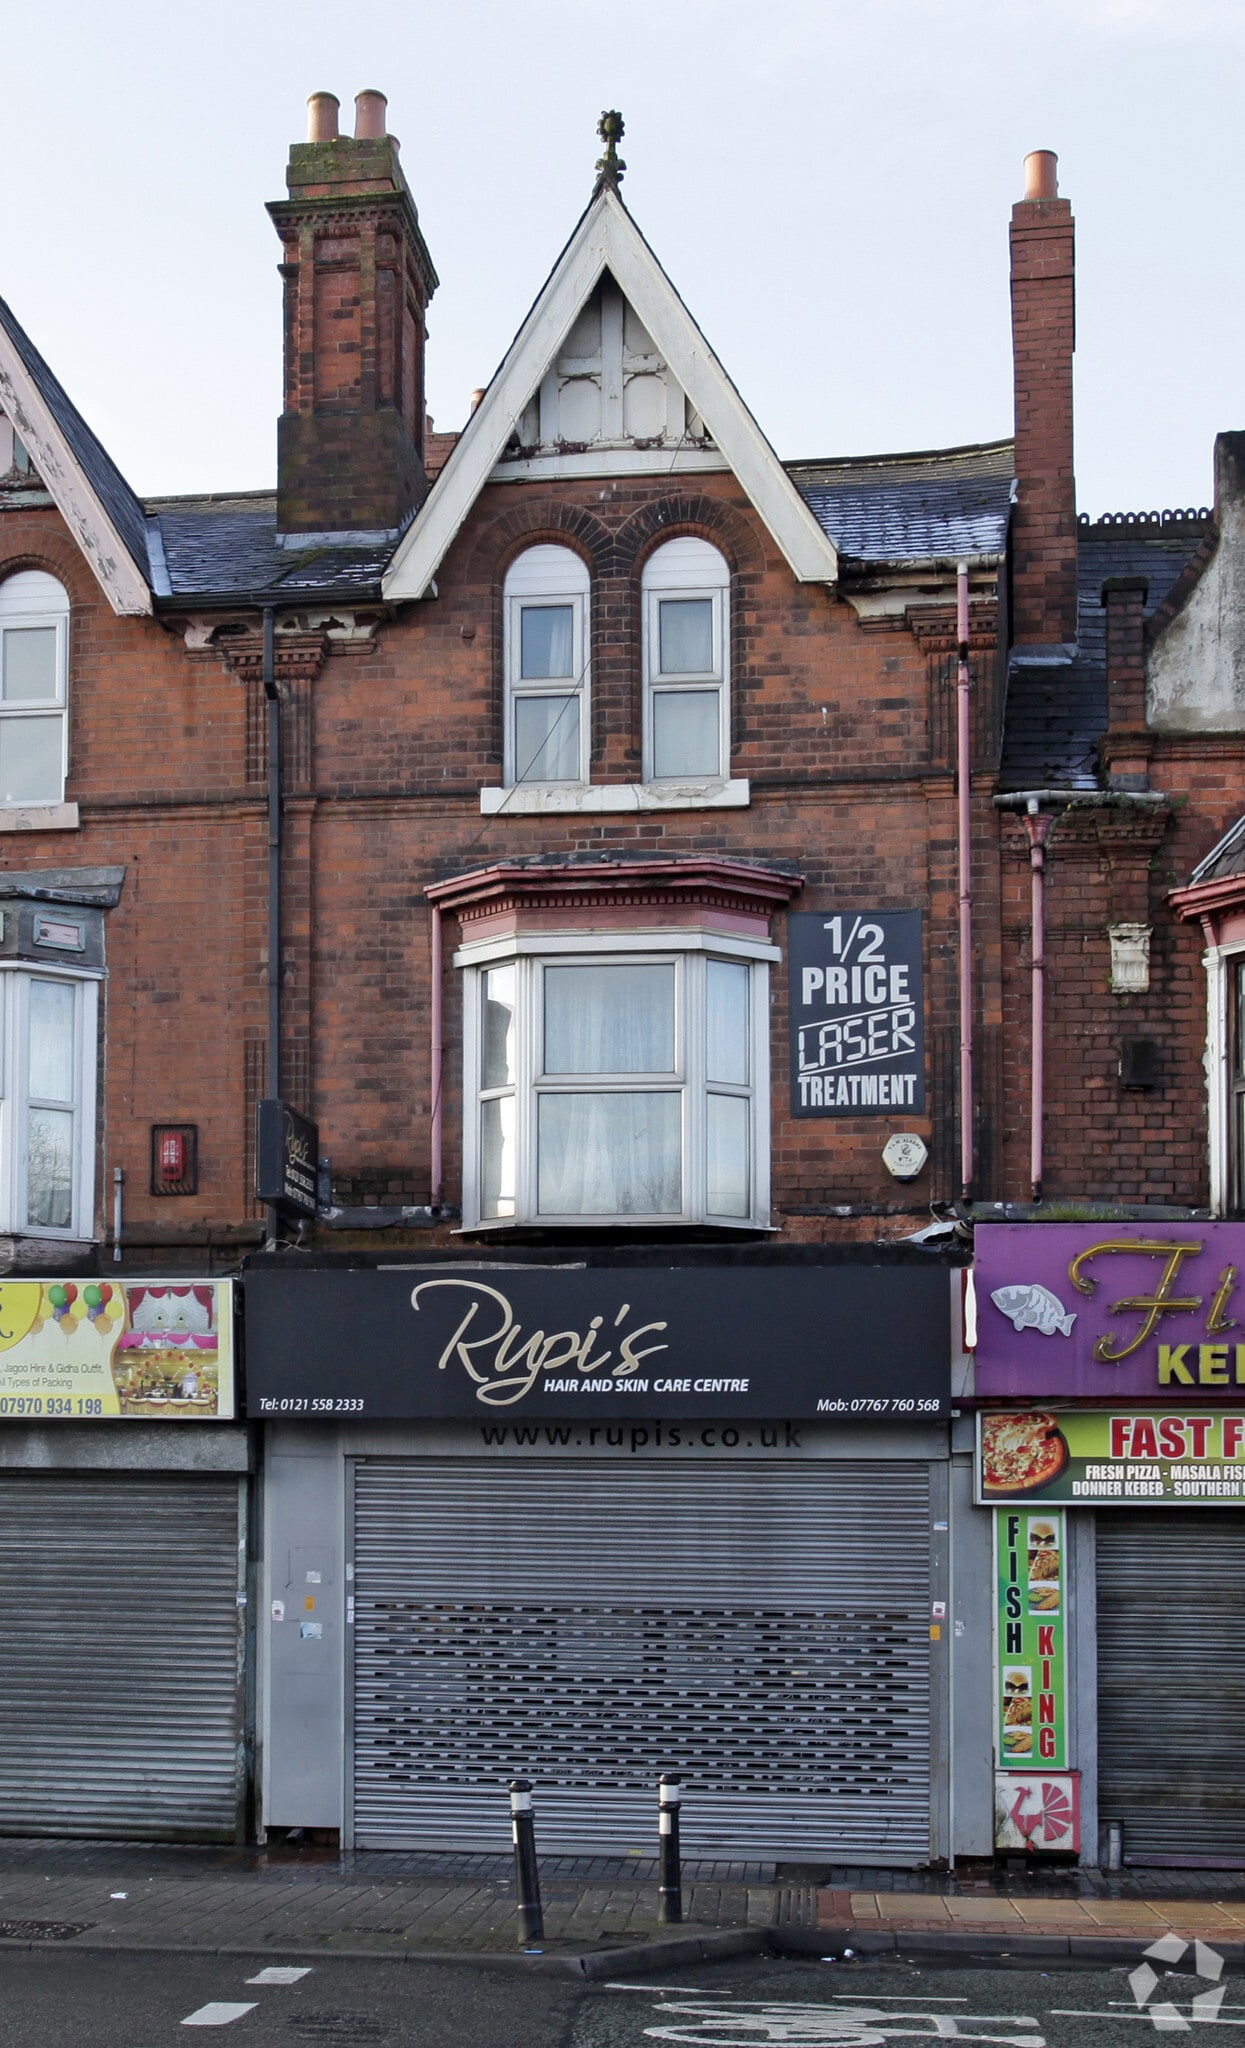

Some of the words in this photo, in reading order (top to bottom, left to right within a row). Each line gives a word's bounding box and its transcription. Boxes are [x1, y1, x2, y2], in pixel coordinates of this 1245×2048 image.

[823, 916, 885, 963] 1/2
[802, 964, 911, 1005] PRICE
[798, 1007, 916, 1071] LASER
[797, 1074, 917, 1107] TREATMENT
[410, 1279, 669, 1406] Rupi's
[4, 1363, 28, 1376] Jagoo
[30, 1363, 46, 1373] Hire
[48, 1364, 54, 1373] &
[56, 1364, 80, 1374] Gidha
[1157, 1343, 1245, 1385] KE
[7, 1376, 30, 1389] Types
[32, 1377, 40, 1387] of
[42, 1377, 73, 1390] Packing
[543, 1378, 579, 1392] HAIR
[580, 1378, 613, 1392] AND
[615, 1378, 649, 1392] SKIN
[653, 1378, 692, 1392] CARE
[693, 1378, 749, 1392] CENTRE
[0, 1397, 42, 1414] 07970
[47, 1398, 72, 1415] 934
[77, 1398, 102, 1415] 198
[260, 1397, 279, 1410] Tel:
[280, 1398, 309, 1411] 0121
[311, 1398, 334, 1411] 558
[334, 1398, 364, 1411] 2333
[816, 1398, 849, 1412] Mob:
[850, 1399, 890, 1412] 07767
[891, 1399, 915, 1412] 760
[916, 1399, 940, 1412] 568
[480, 1420, 802, 1452] www.rupis.co.uk
[1109, 1416, 1214, 1460] FAST
[1221, 1416, 1245, 1460] F
[1085, 1464, 1124, 1480] FRESH
[1127, 1464, 1161, 1480] PIZZA
[1170, 1464, 1220, 1480] MASALA
[1072, 1481, 1122, 1496] DONNER
[1125, 1481, 1164, 1496] KEBEB
[1174, 1481, 1239, 1496] SOUTHERN
[1005, 1515, 1022, 1655] FISH
[1037, 1624, 1056, 1759] KING
